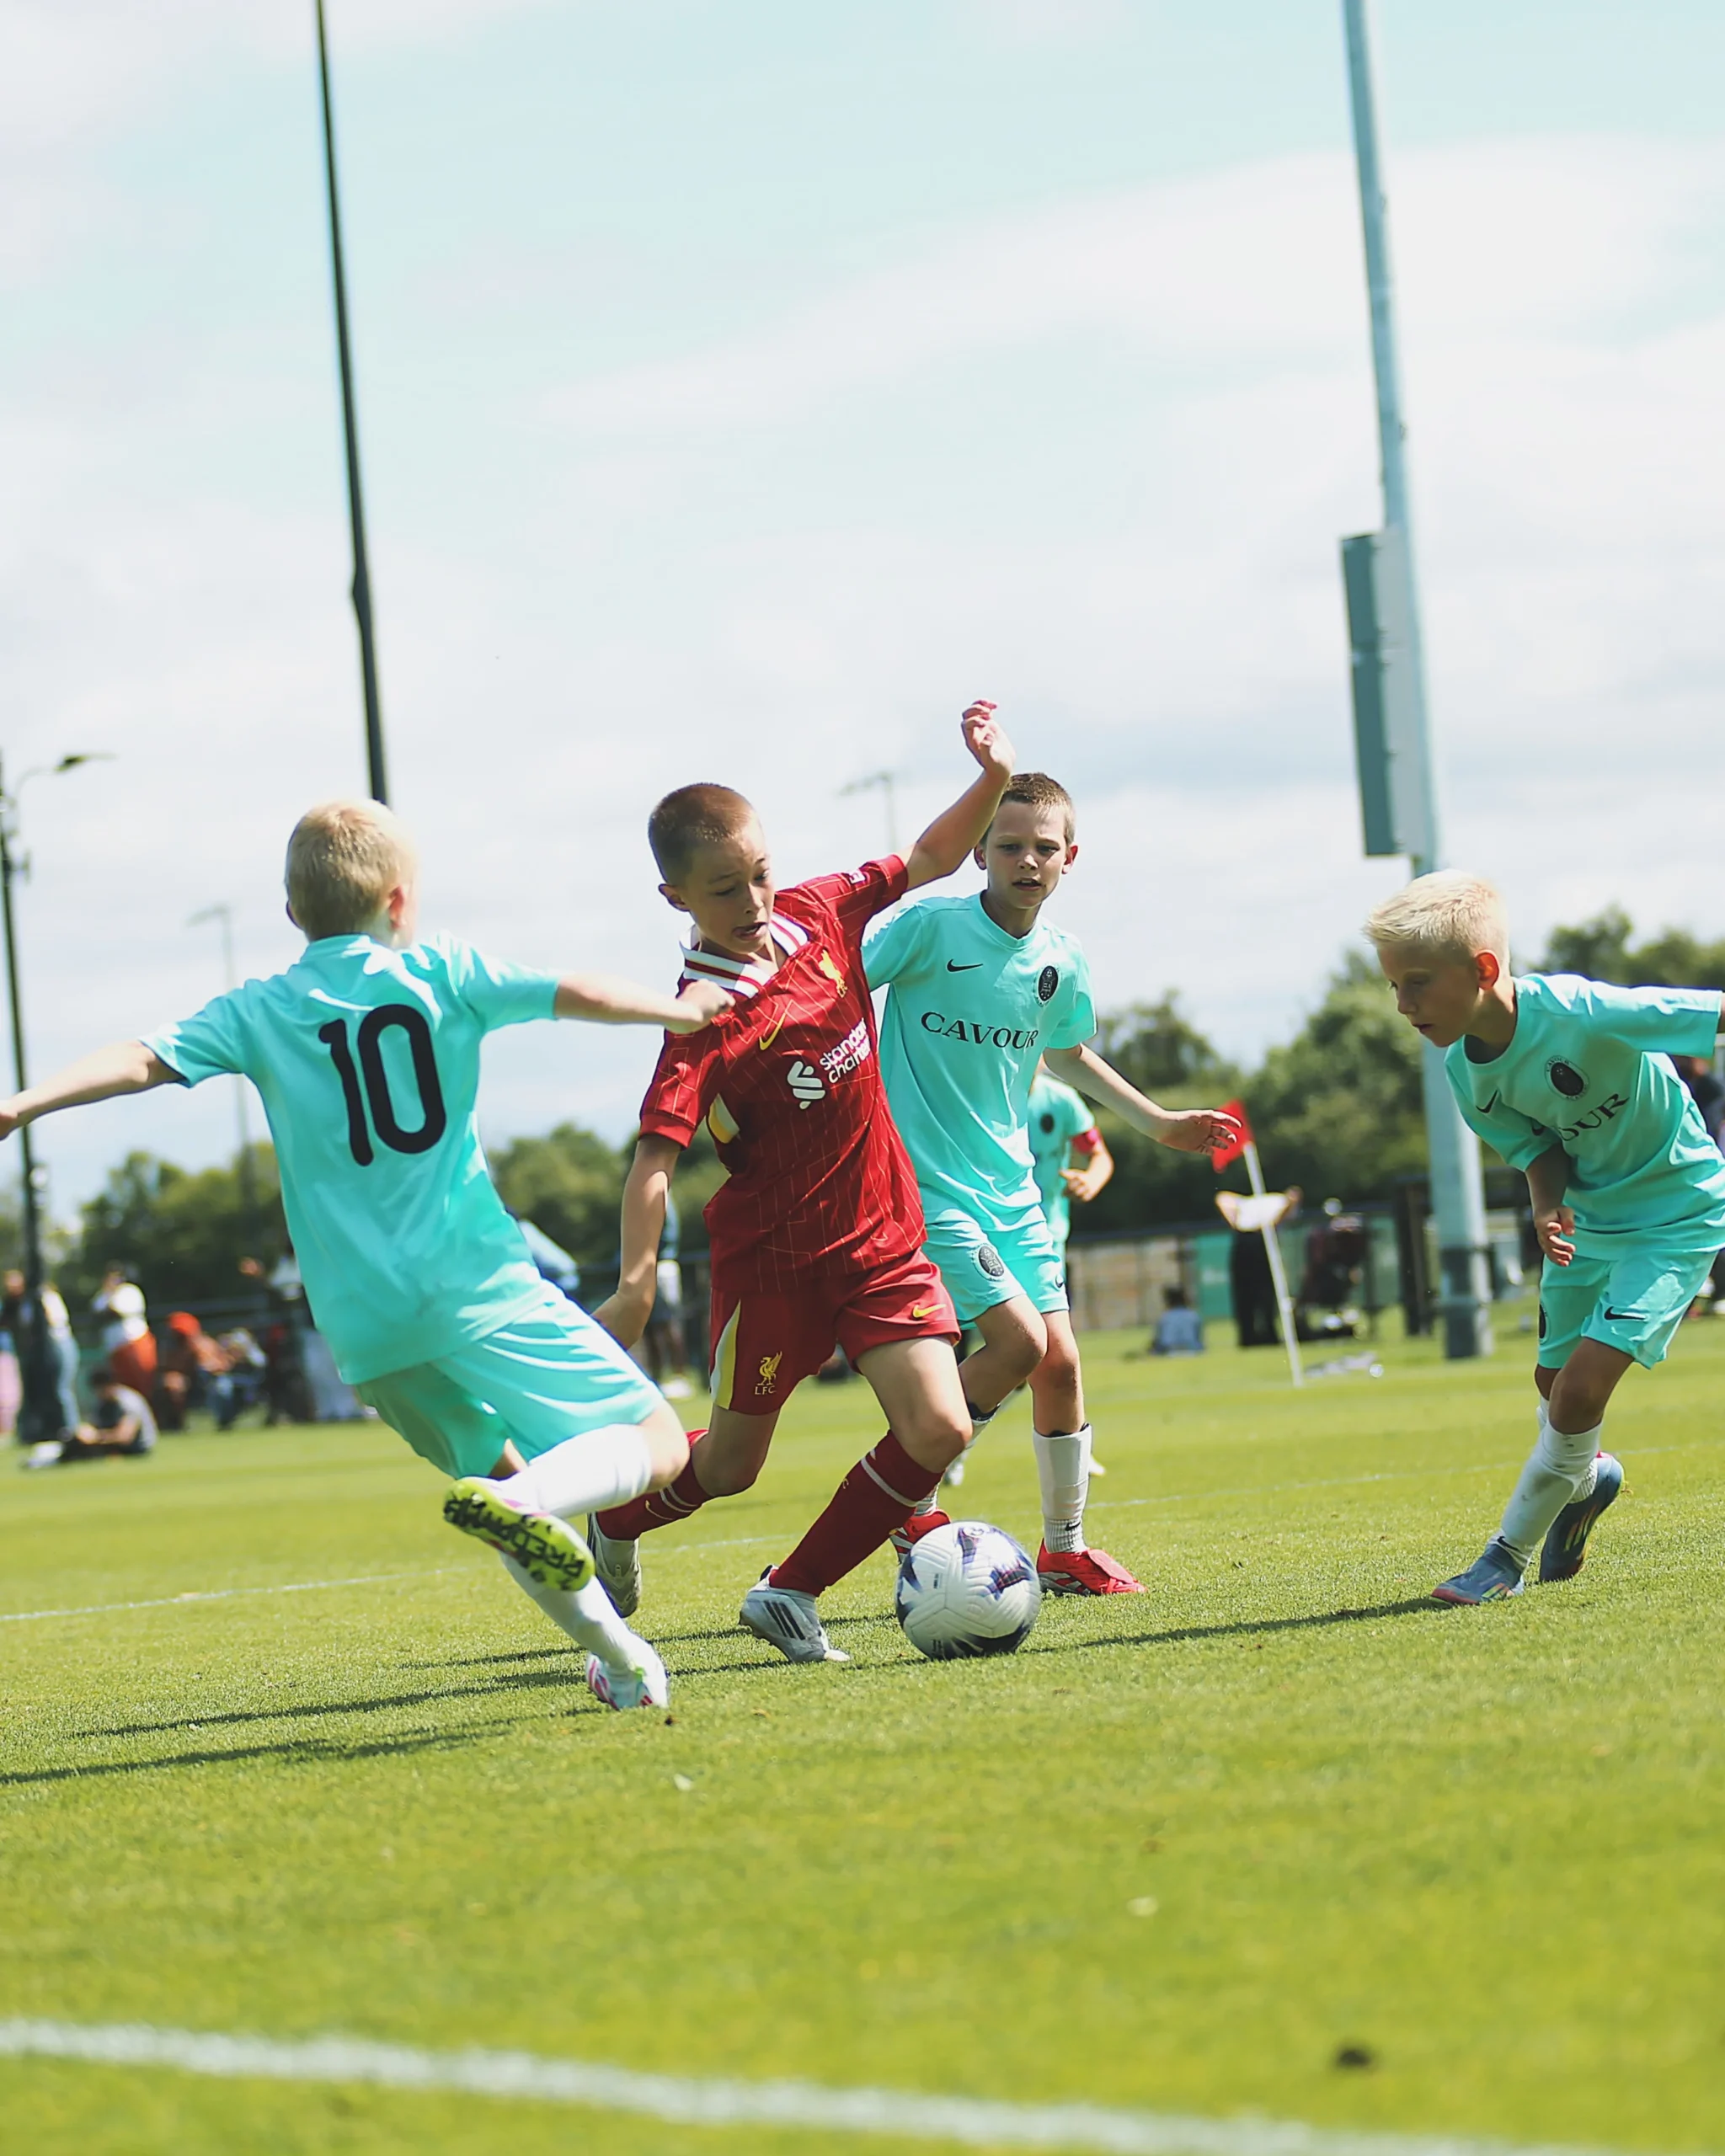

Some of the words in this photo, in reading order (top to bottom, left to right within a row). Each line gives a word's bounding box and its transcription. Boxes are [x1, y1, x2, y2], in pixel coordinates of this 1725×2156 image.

[921, 1011, 1039, 1049] CAVOUR
[318, 1004, 446, 1166] 10
[755, 1385, 777, 1396] LFC
